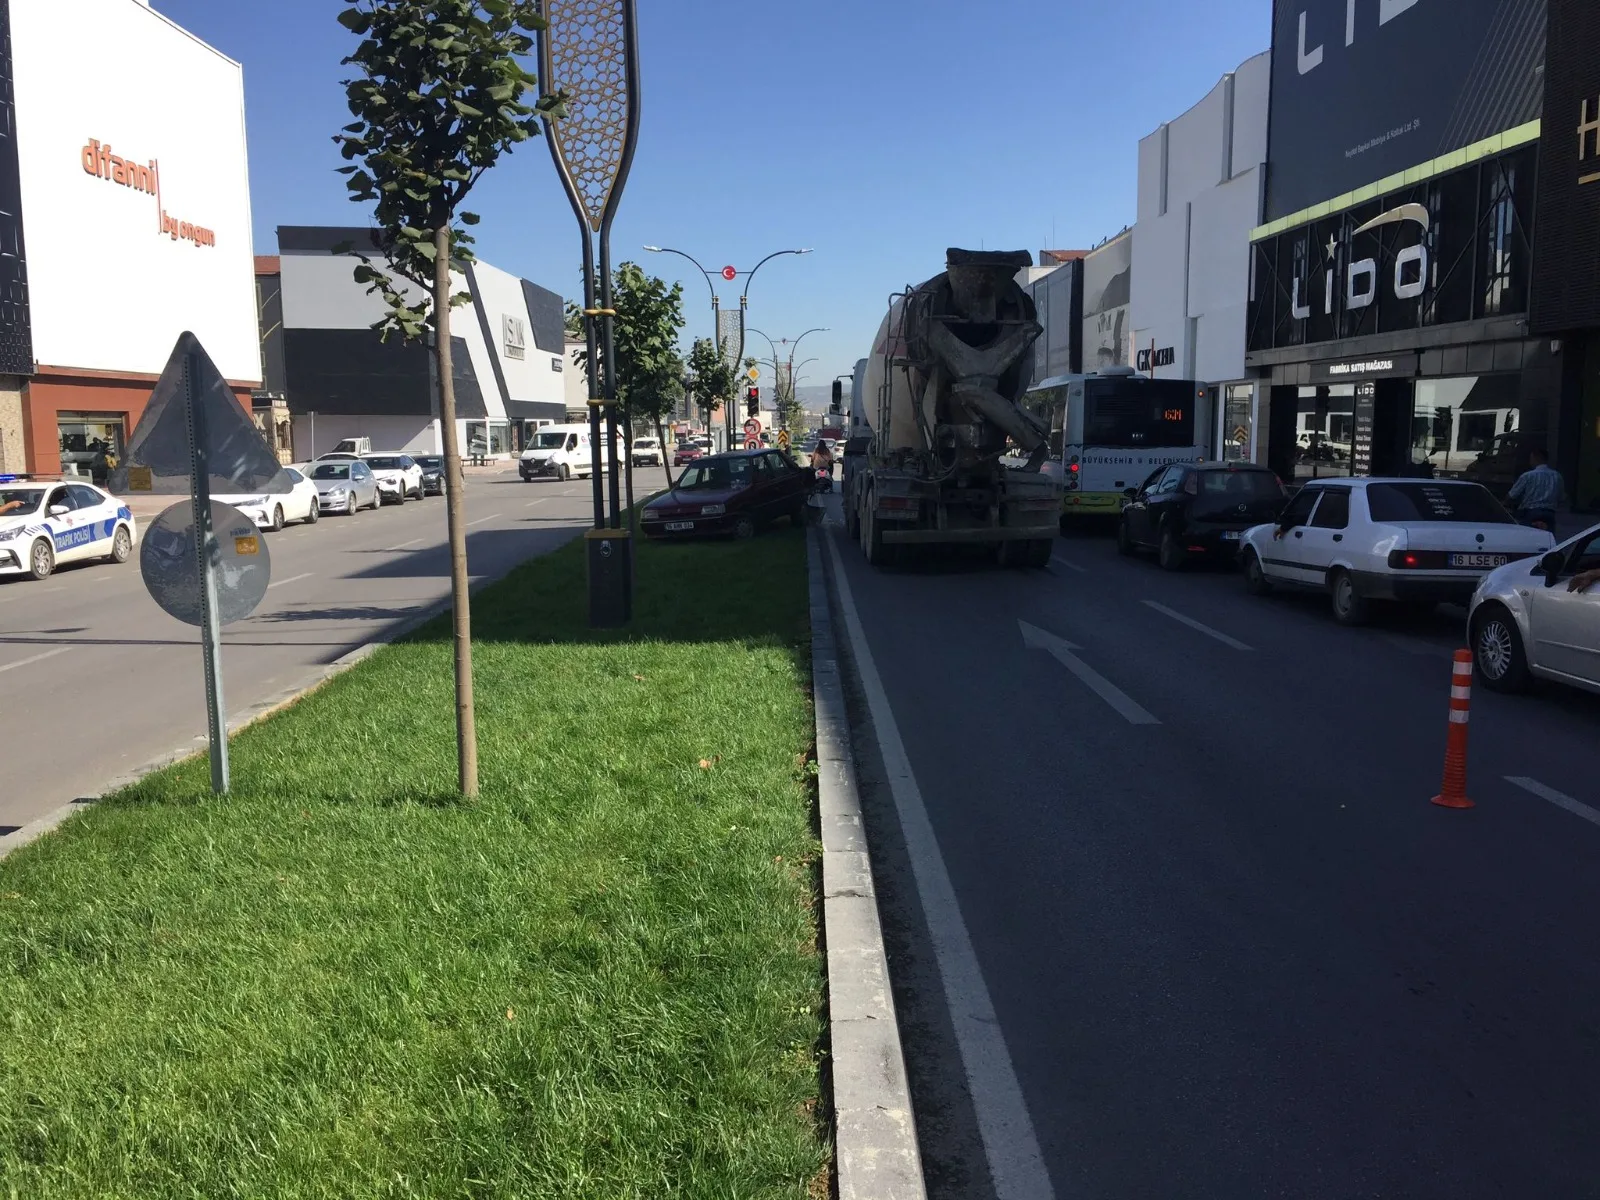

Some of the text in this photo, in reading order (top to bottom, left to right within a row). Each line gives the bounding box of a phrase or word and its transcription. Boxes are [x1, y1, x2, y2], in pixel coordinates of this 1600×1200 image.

[82, 137, 156, 196] difanni
[162, 210, 215, 247] by ongun
[55, 532, 73, 548] TRAFİK
[1454, 555, 1506, 566] 16 LSE 60
